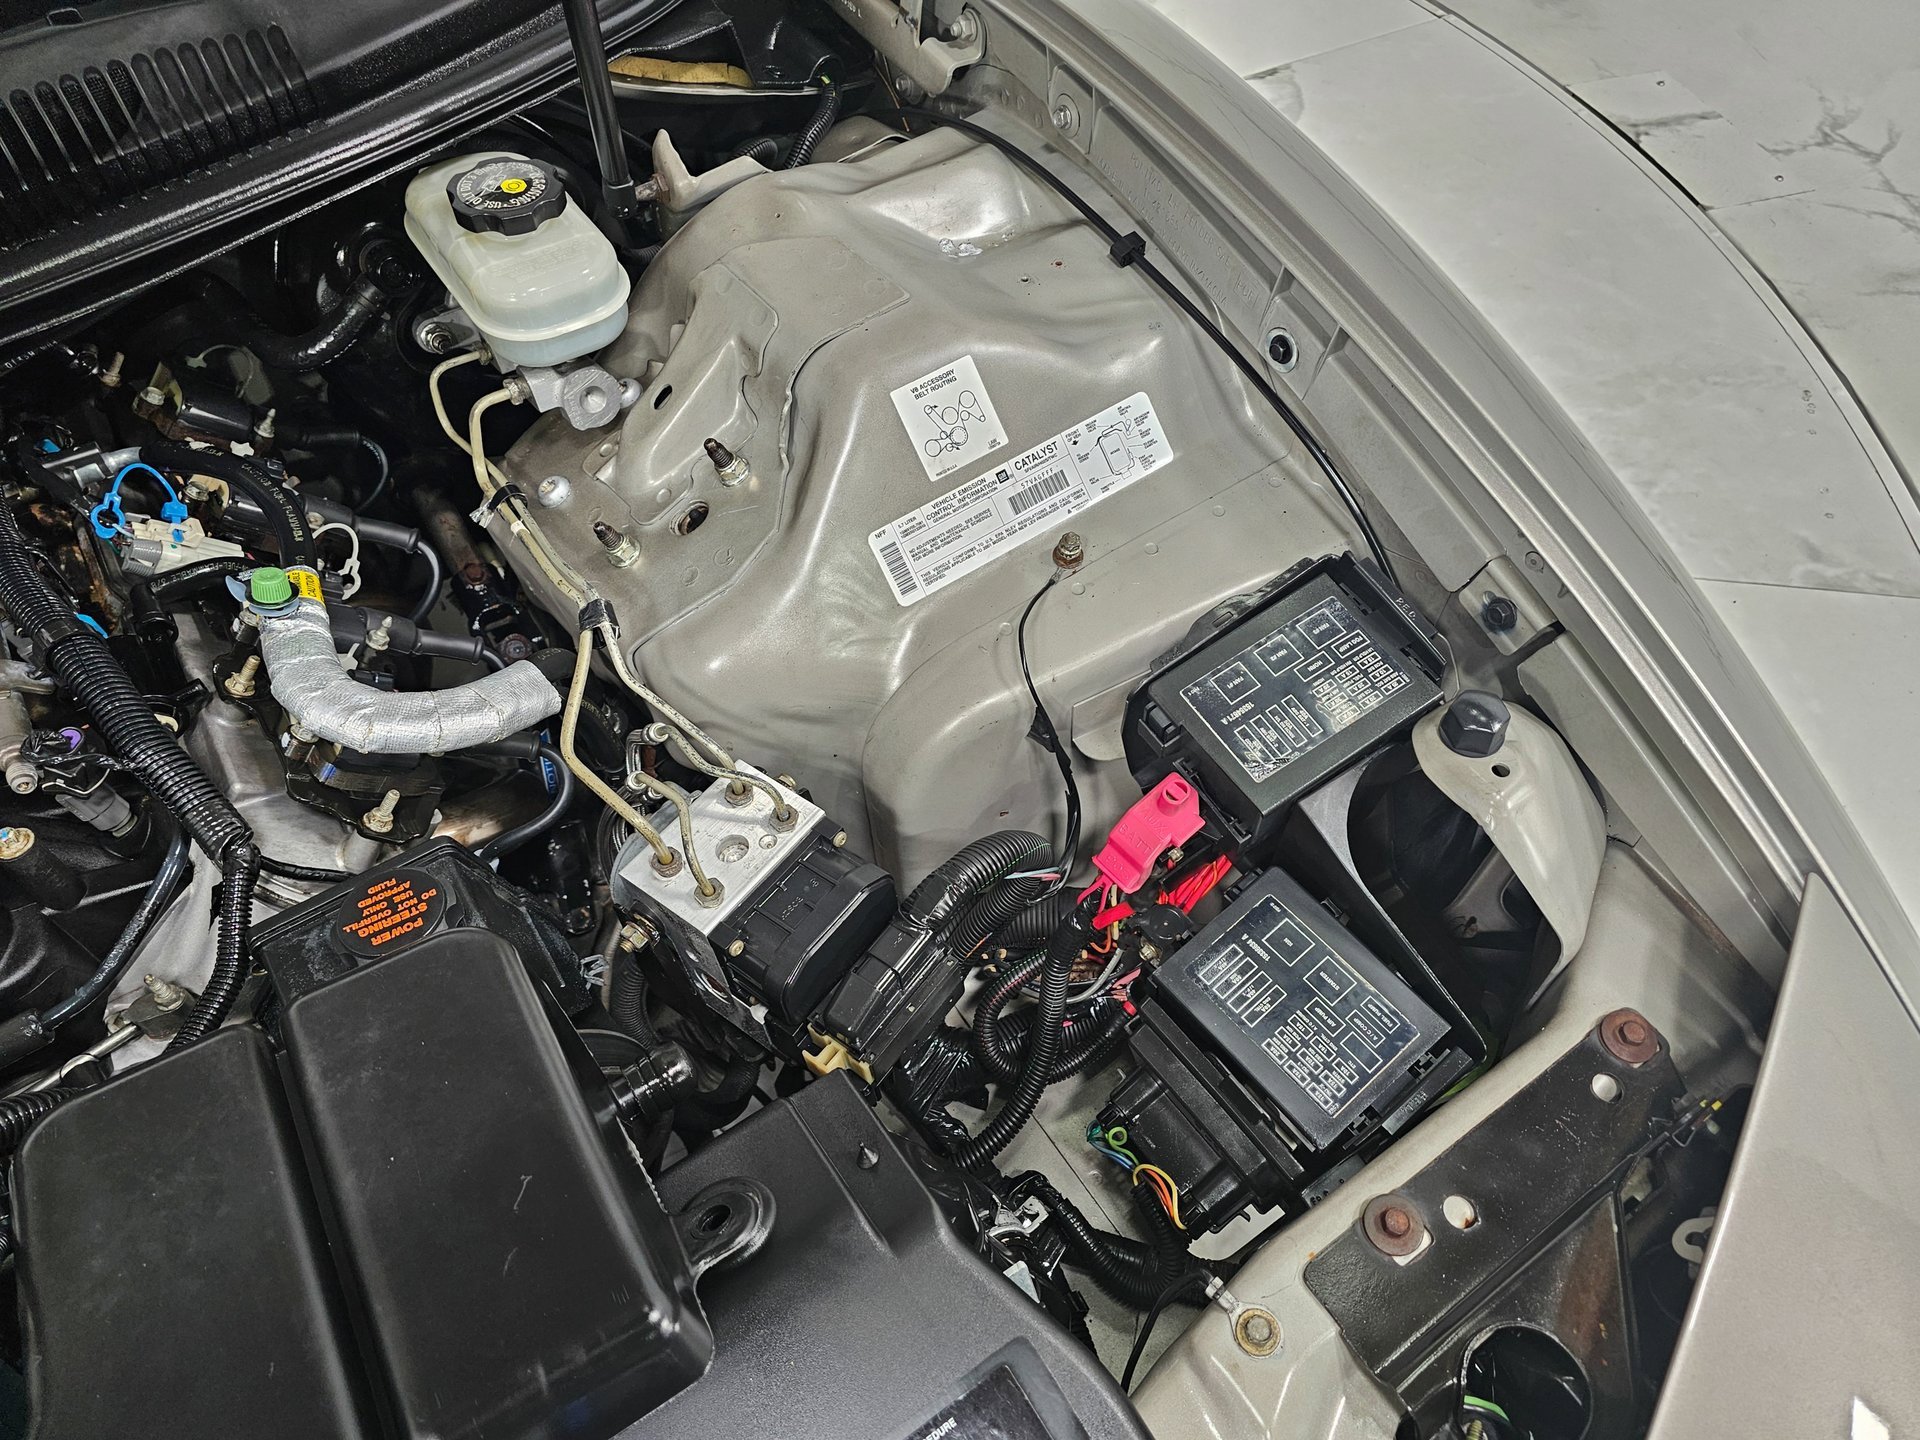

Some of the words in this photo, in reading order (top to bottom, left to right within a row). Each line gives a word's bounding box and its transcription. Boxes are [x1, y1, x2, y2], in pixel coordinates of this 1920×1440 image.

[909, 386, 919, 394] V8
[919, 368, 954, 389] ACCESSORY
[913, 388, 929, 400] BELT
[929, 375, 957, 392] ROUTING
[1014, 440, 1057, 470] CATALYST
[925, 502, 955, 520] CONTROL
[956, 479, 997, 504] INFORMATION
[930, 492, 957, 509] VEHICLE
[957, 477, 986, 496] EMISSION
[932, 511, 952, 523] GENERAL
[951, 501, 969, 513] MOTORS
[969, 486, 998, 504] CORPORATION
[904, 515, 916, 525] LITER
[874, 528, 886, 539] NFF
[910, 547, 928, 558] MANUAL
[939, 524, 970, 542] MAINTENANCE
[970, 511, 992, 526] SCHEDULE
[915, 531, 945, 550] ADJUSTMENTS
[972, 507, 990, 519] SERVICE
[920, 570, 931, 578] THIS
[932, 559, 951, 572] VEHICLE
[952, 545, 976, 561] CONFORMS
[1017, 507, 1047, 526] REGULATIONS
[1048, 501, 1057, 509] AND
[1058, 487, 1083, 503] CALIFORNIA
[922, 564, 951, 582] REGULATIONS
[950, 551, 976, 567] APPLICABLE
[1017, 523, 1027, 531] NEW
[1027, 518, 1036, 526] LEV
[1035, 505, 1059, 520] PASSENGER
[912, 554, 922, 562] FOR
[921, 548, 934, 557] MORE
[305, 574, 316, 597] CAUTION
[1318, 622, 1329, 631] FAN
[1338, 641, 1353, 652] LAMP
[1350, 635, 1363, 644] FOG
[1275, 648, 1287, 657] FAN
[1307, 659, 1323, 671] HORN
[1232, 675, 1244, 685] FAN
[1220, 717, 1228, 725] A
[1119, 823, 1154, 855] BATT
[367, 878, 396, 894] FLUID
[357, 880, 410, 907] APPROVED
[392, 890, 413, 903] USE
[420, 888, 436, 900] DO
[362, 901, 387, 916] ONLY
[397, 897, 418, 911] NOT
[342, 909, 391, 932] OVERFILL
[357, 902, 427, 937] STEERING
[371, 917, 423, 945] POWER
[1240, 932, 1249, 940] A
[1319, 971, 1339, 990] STARTER
[1314, 1006, 1328, 1020] PUMP
[1367, 1003, 1381, 1016] PUMP
[1326, 1017, 1336, 1027] AIR
[1353, 1017, 1367, 1031] COMP
[1380, 1014, 1393, 1027] FUEL
[1347, 1059, 1356, 1069] ETC
[922, 1416, 958, 1440] EDURE
